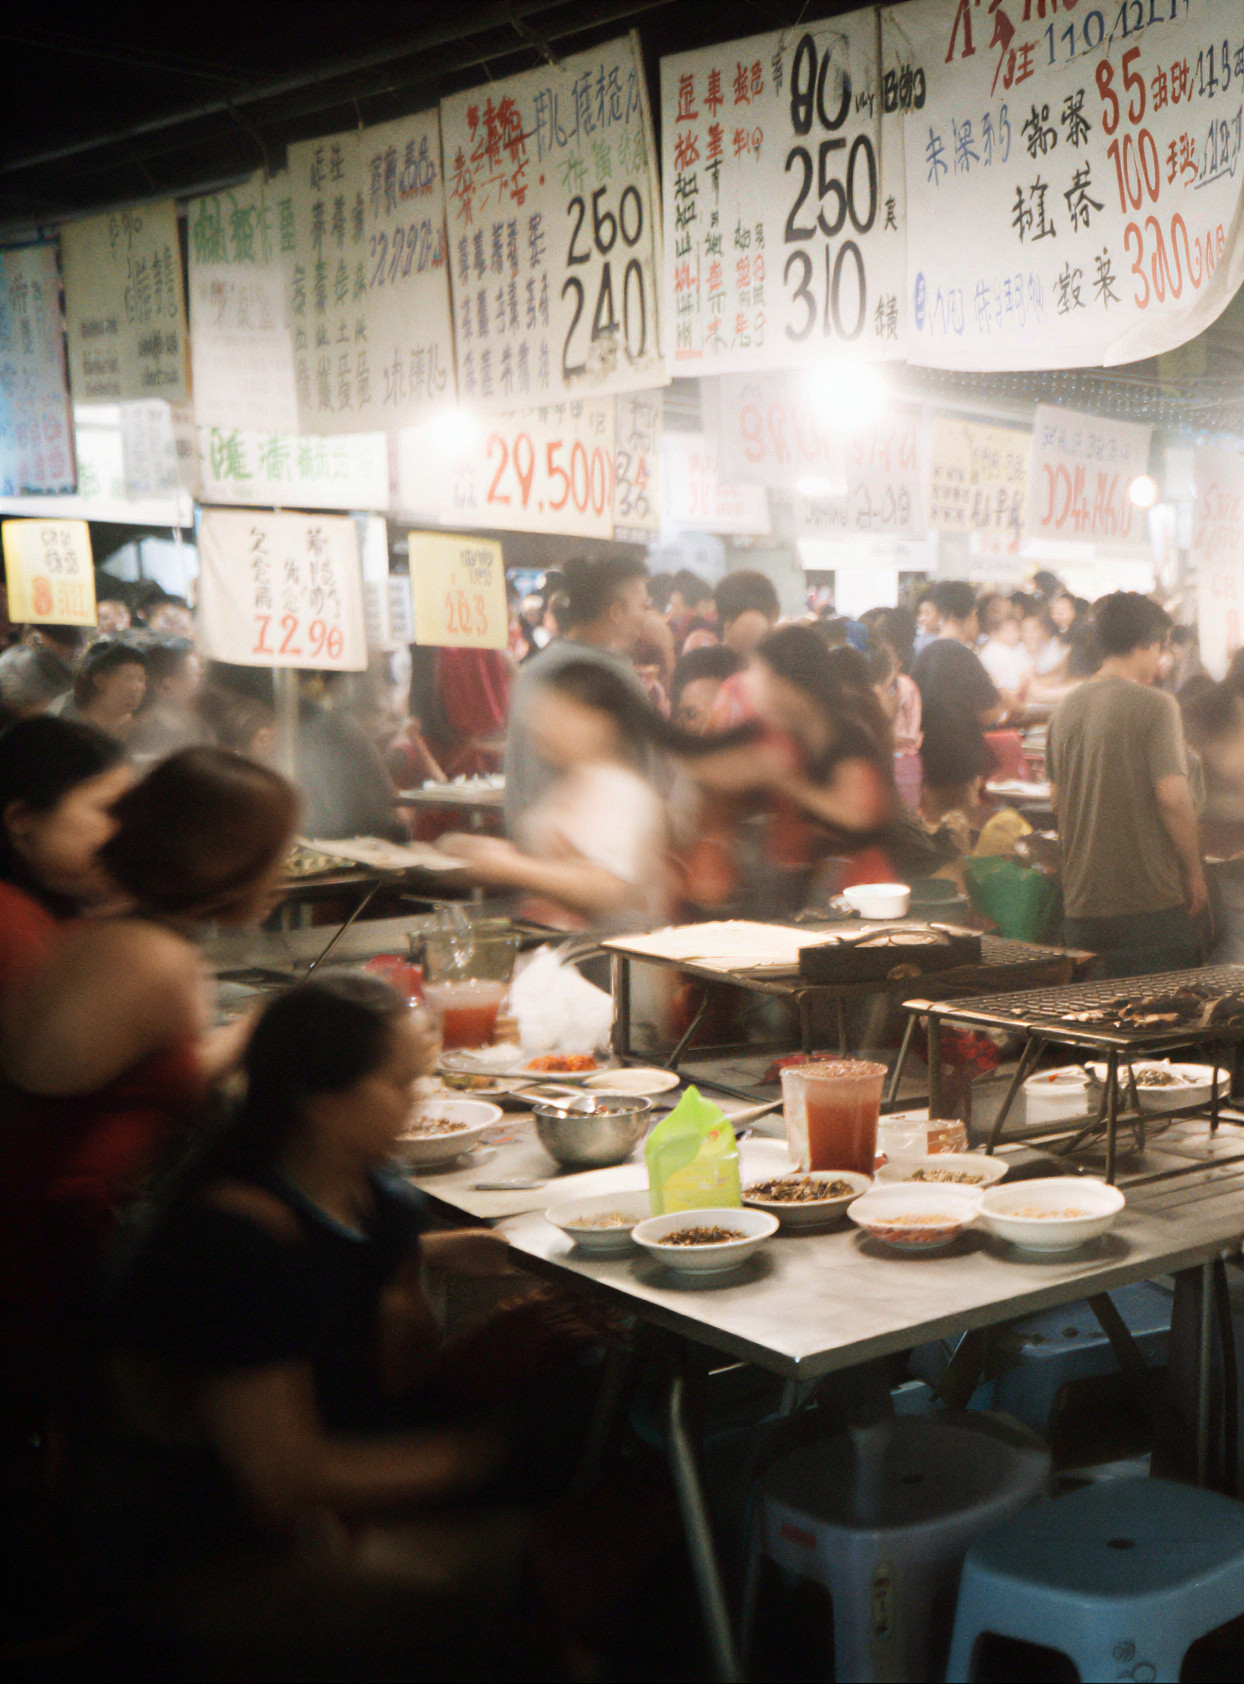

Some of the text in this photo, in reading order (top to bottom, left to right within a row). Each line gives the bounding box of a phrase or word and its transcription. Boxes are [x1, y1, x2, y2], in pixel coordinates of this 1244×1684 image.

[784, 134, 878, 244] 250
[1106, 128, 1160, 214] 100
[566, 184, 644, 268] 260
[561, 258, 646, 389] 240
[783, 240, 867, 343] 310
